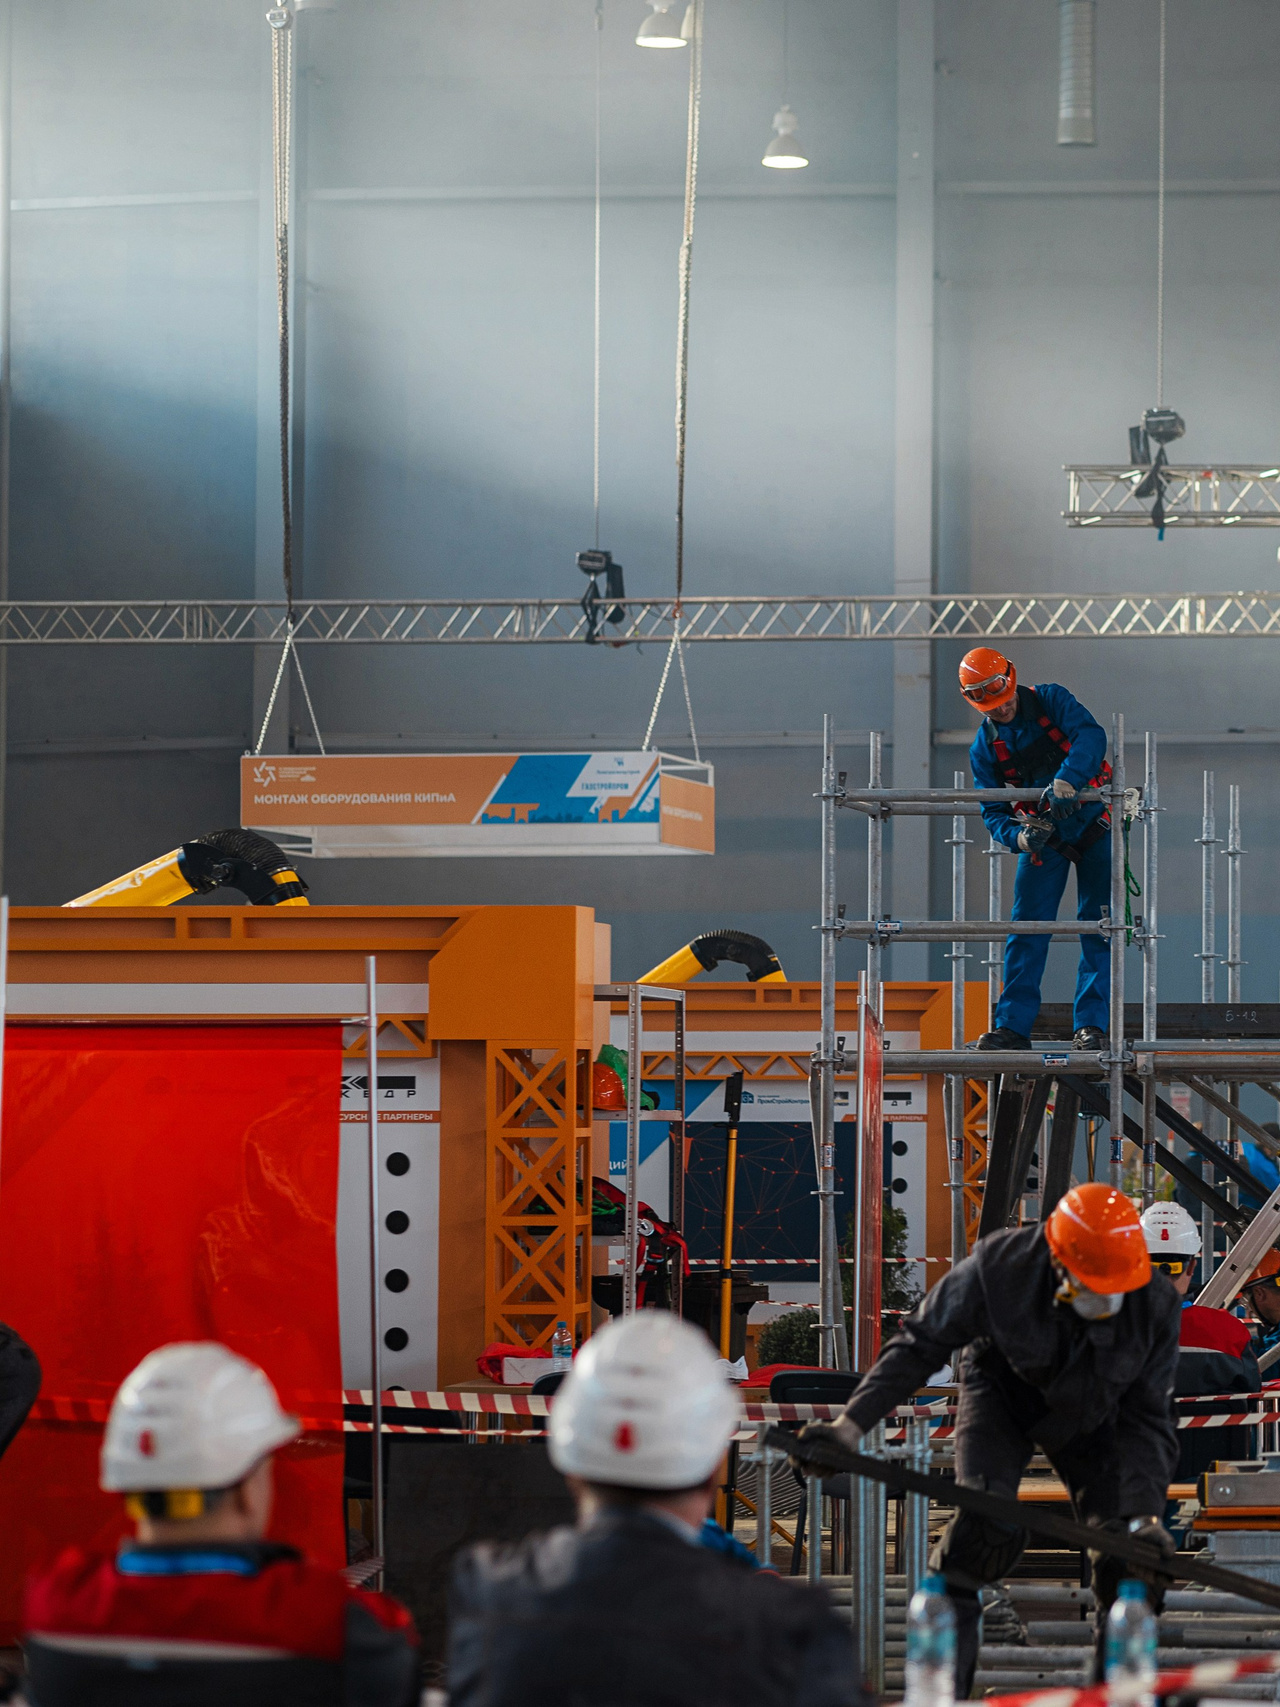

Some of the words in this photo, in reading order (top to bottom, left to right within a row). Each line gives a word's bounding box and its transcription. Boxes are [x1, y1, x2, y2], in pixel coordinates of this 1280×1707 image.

[254, 794, 308, 805] МОНТАЖ
[311, 793, 412, 806] ОБОРУДОВАНИЯ
[414, 792, 456, 804] КИПиА
[383, 1113, 433, 1121] ПАРТНЕРЫ
